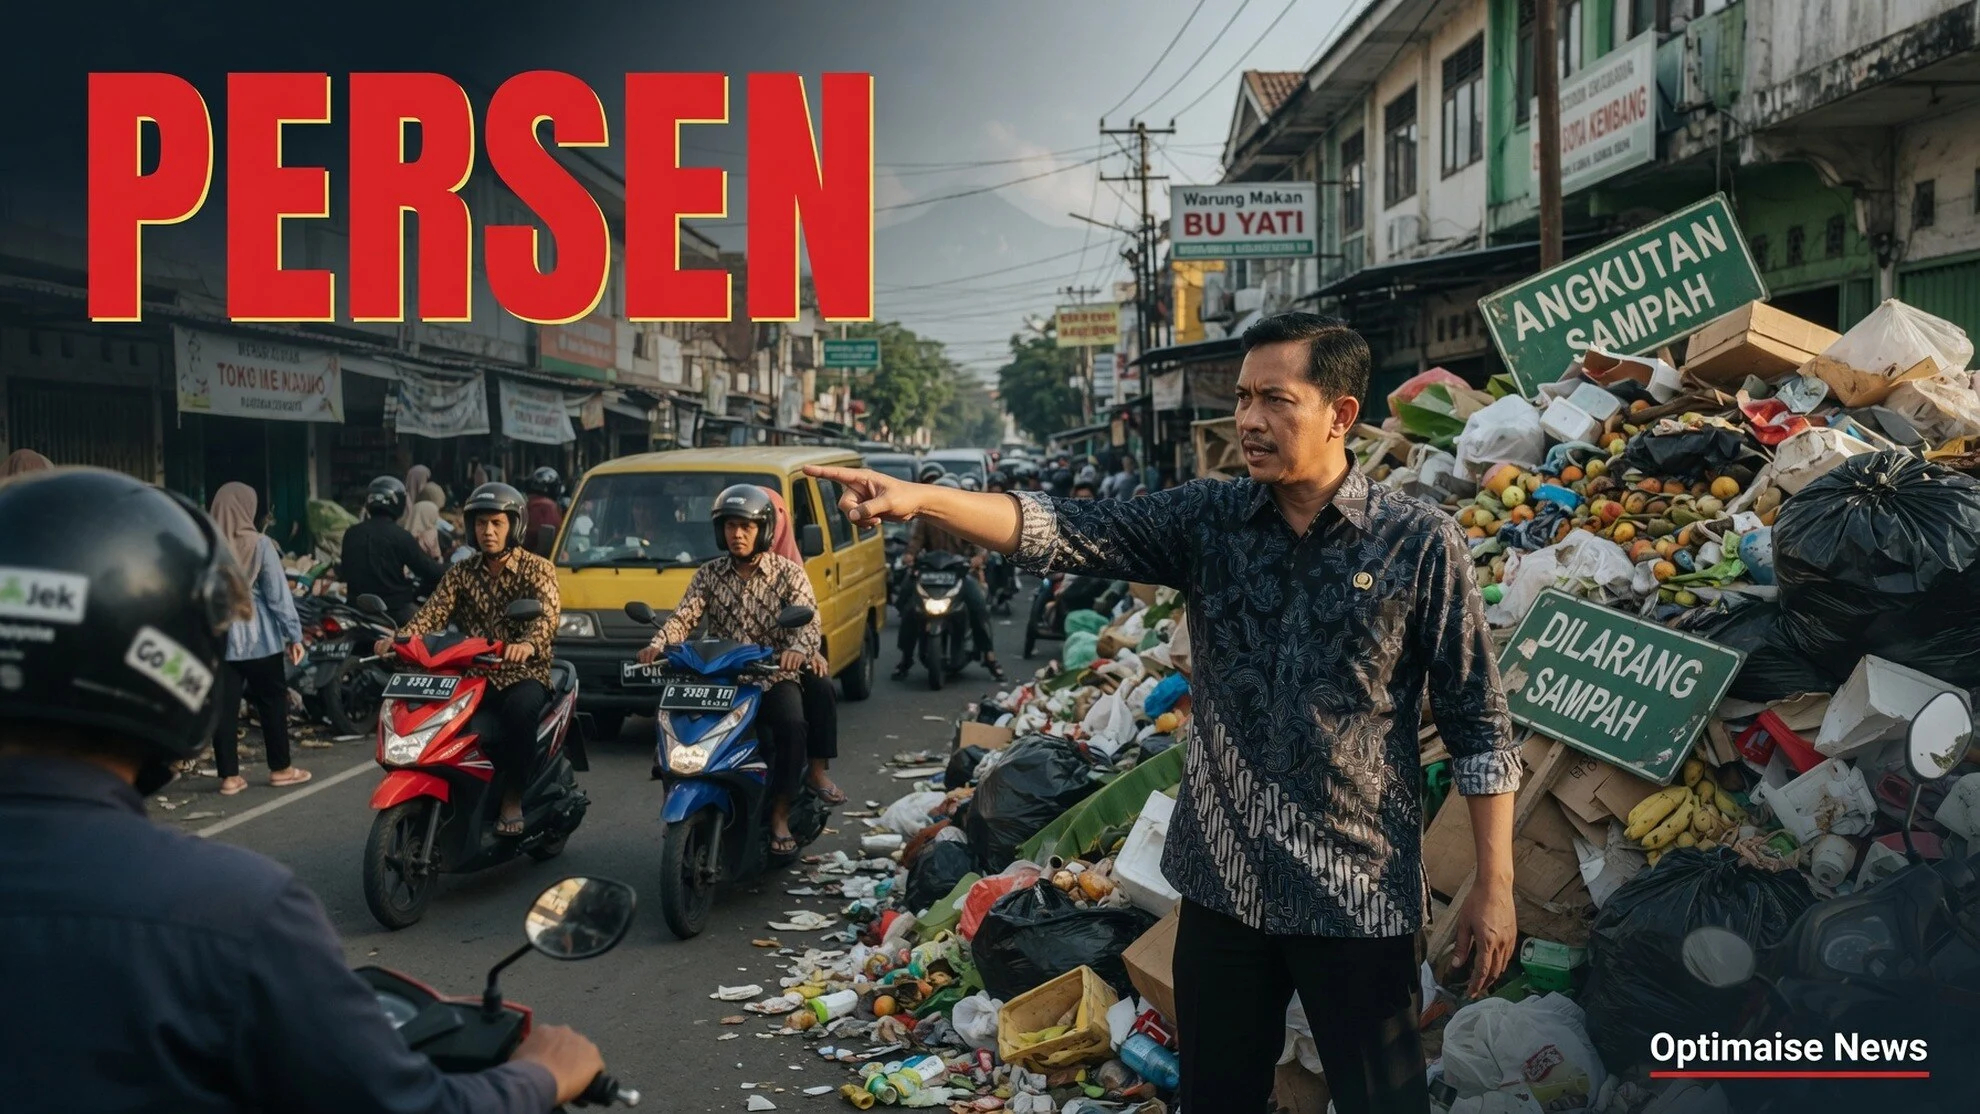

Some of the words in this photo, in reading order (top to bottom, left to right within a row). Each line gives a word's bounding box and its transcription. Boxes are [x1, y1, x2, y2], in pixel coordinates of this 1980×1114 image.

[1589, 85, 1647, 142] KEMBANG
[1183, 191, 1245, 208] Warung
[1249, 191, 1303, 204] Makan
[1184, 212, 1226, 236] BU
[1236, 210, 1304, 235] YATI
[1513, 214, 1728, 342] ANGKUTAN
[1565, 272, 1716, 353] SAMPAH
[216, 362, 256, 389] TOKO
[1537, 610, 1704, 699] DILARANG
[1525, 666, 1649, 742] SAMPAH
